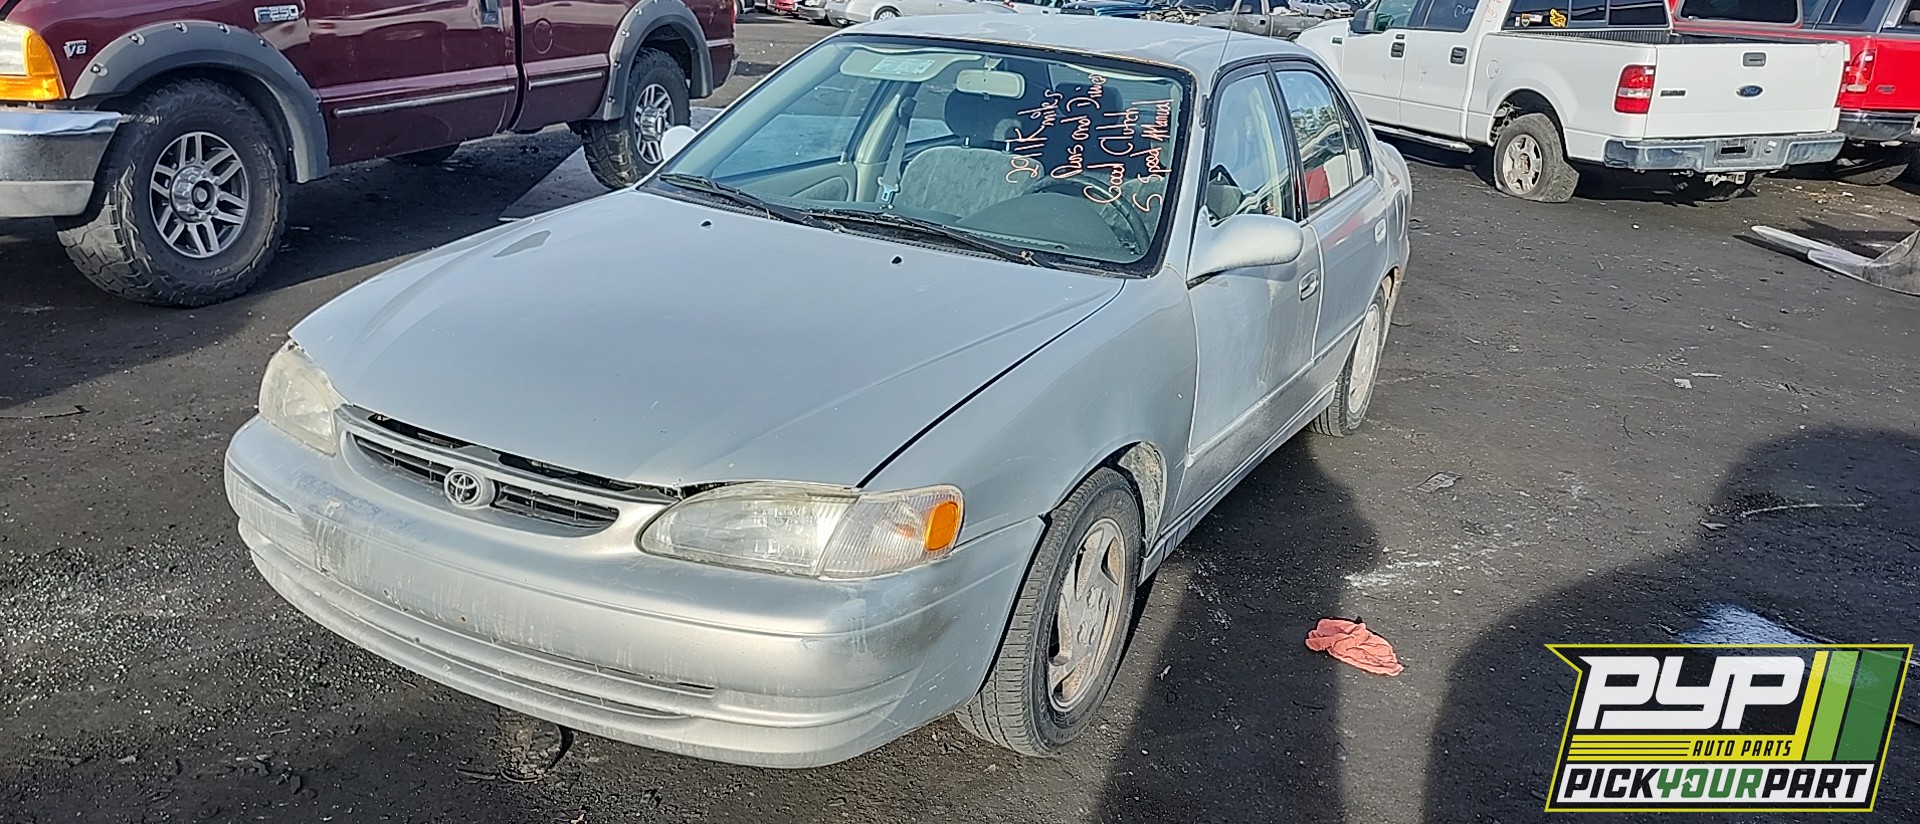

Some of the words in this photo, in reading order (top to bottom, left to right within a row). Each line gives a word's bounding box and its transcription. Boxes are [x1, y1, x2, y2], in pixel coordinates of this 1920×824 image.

[63, 44, 87, 59] V8
[1060, 115, 1091, 140] and
[1096, 107, 1139, 155] Clutch
[1131, 99, 1174, 142] Manual
[1050, 144, 1084, 179] Runs
[1130, 147, 1172, 184] Speed
[1084, 163, 1125, 203] Good
[1132, 193, 1163, 212] 5
